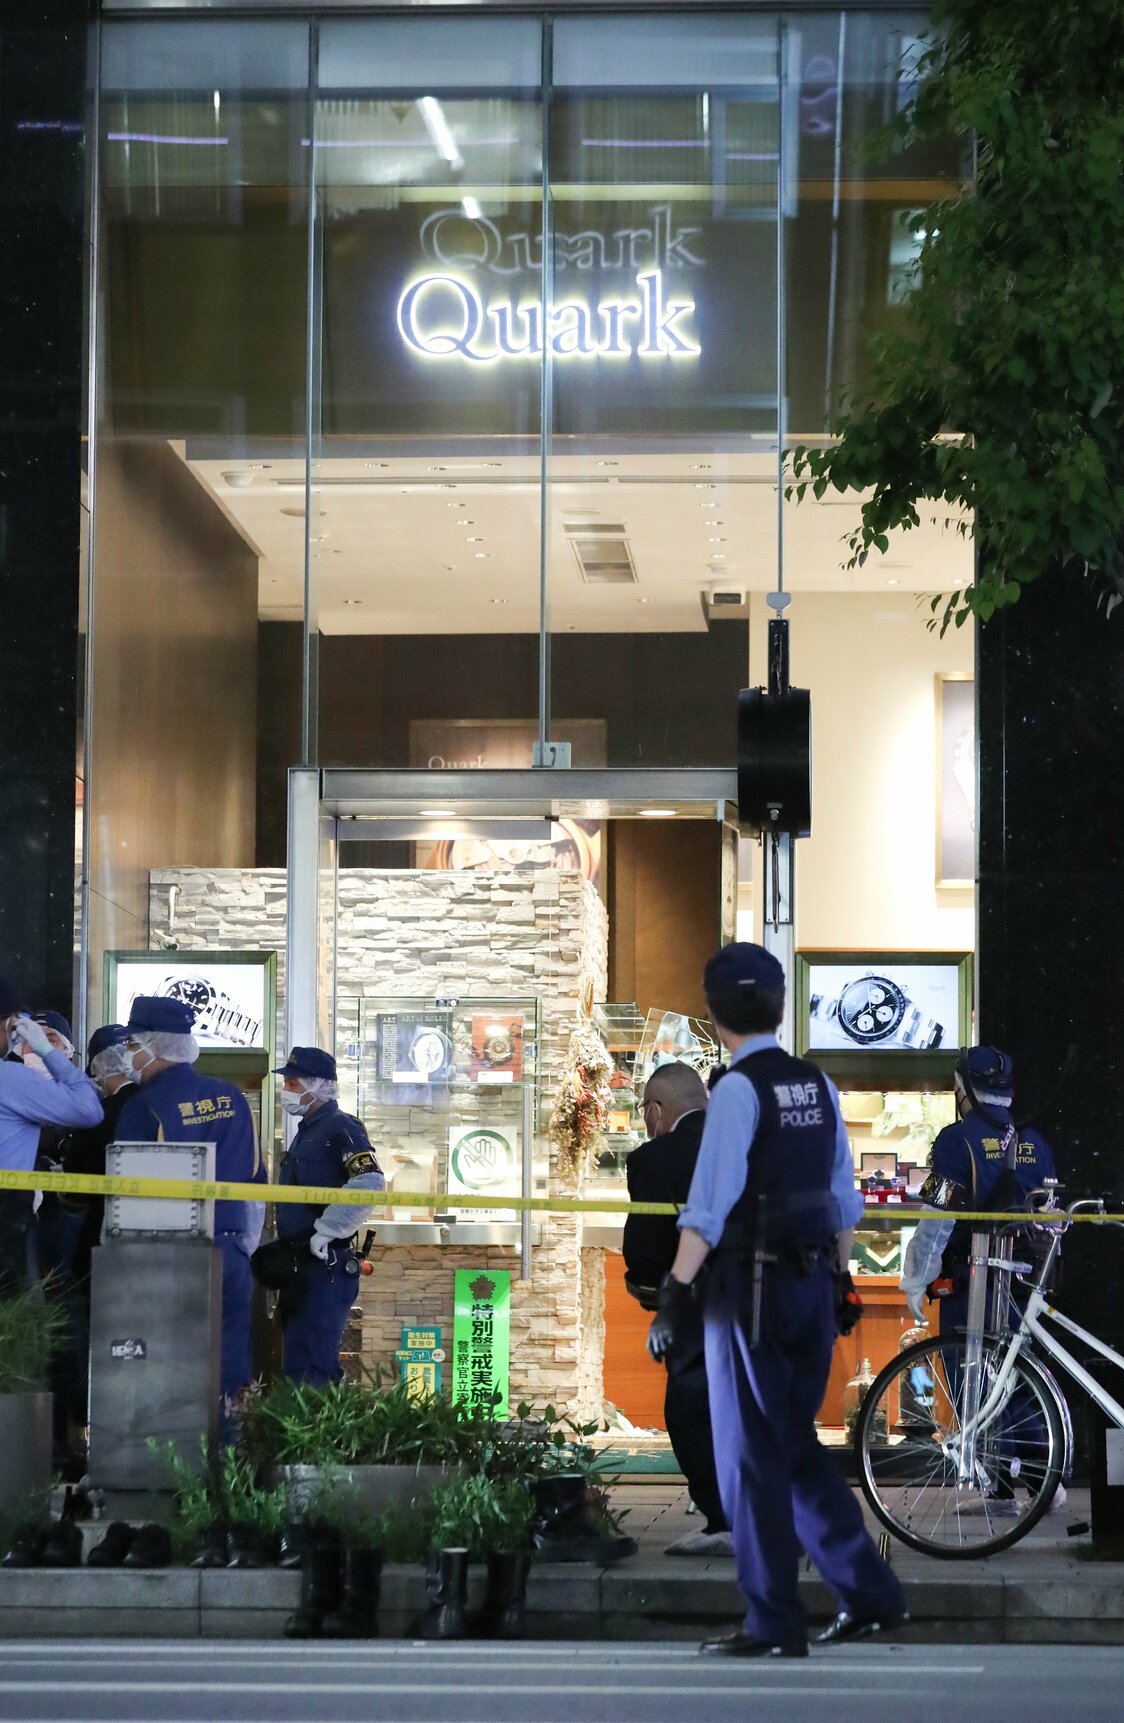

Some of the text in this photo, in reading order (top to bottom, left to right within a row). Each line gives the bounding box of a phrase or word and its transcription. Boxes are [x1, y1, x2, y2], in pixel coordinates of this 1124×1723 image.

[397, 269, 701, 363] Quark
[773, 1082, 819, 1108] 警視庁
[178, 1096, 231, 1117] 警視庁
[183, 1110, 235, 1125] INVESTIGATION
[781, 1109, 823, 1127] POLICE
[981, 1137, 1035, 1155] 警庁
[470, 1303, 494, 1418] 特別警戒実施
